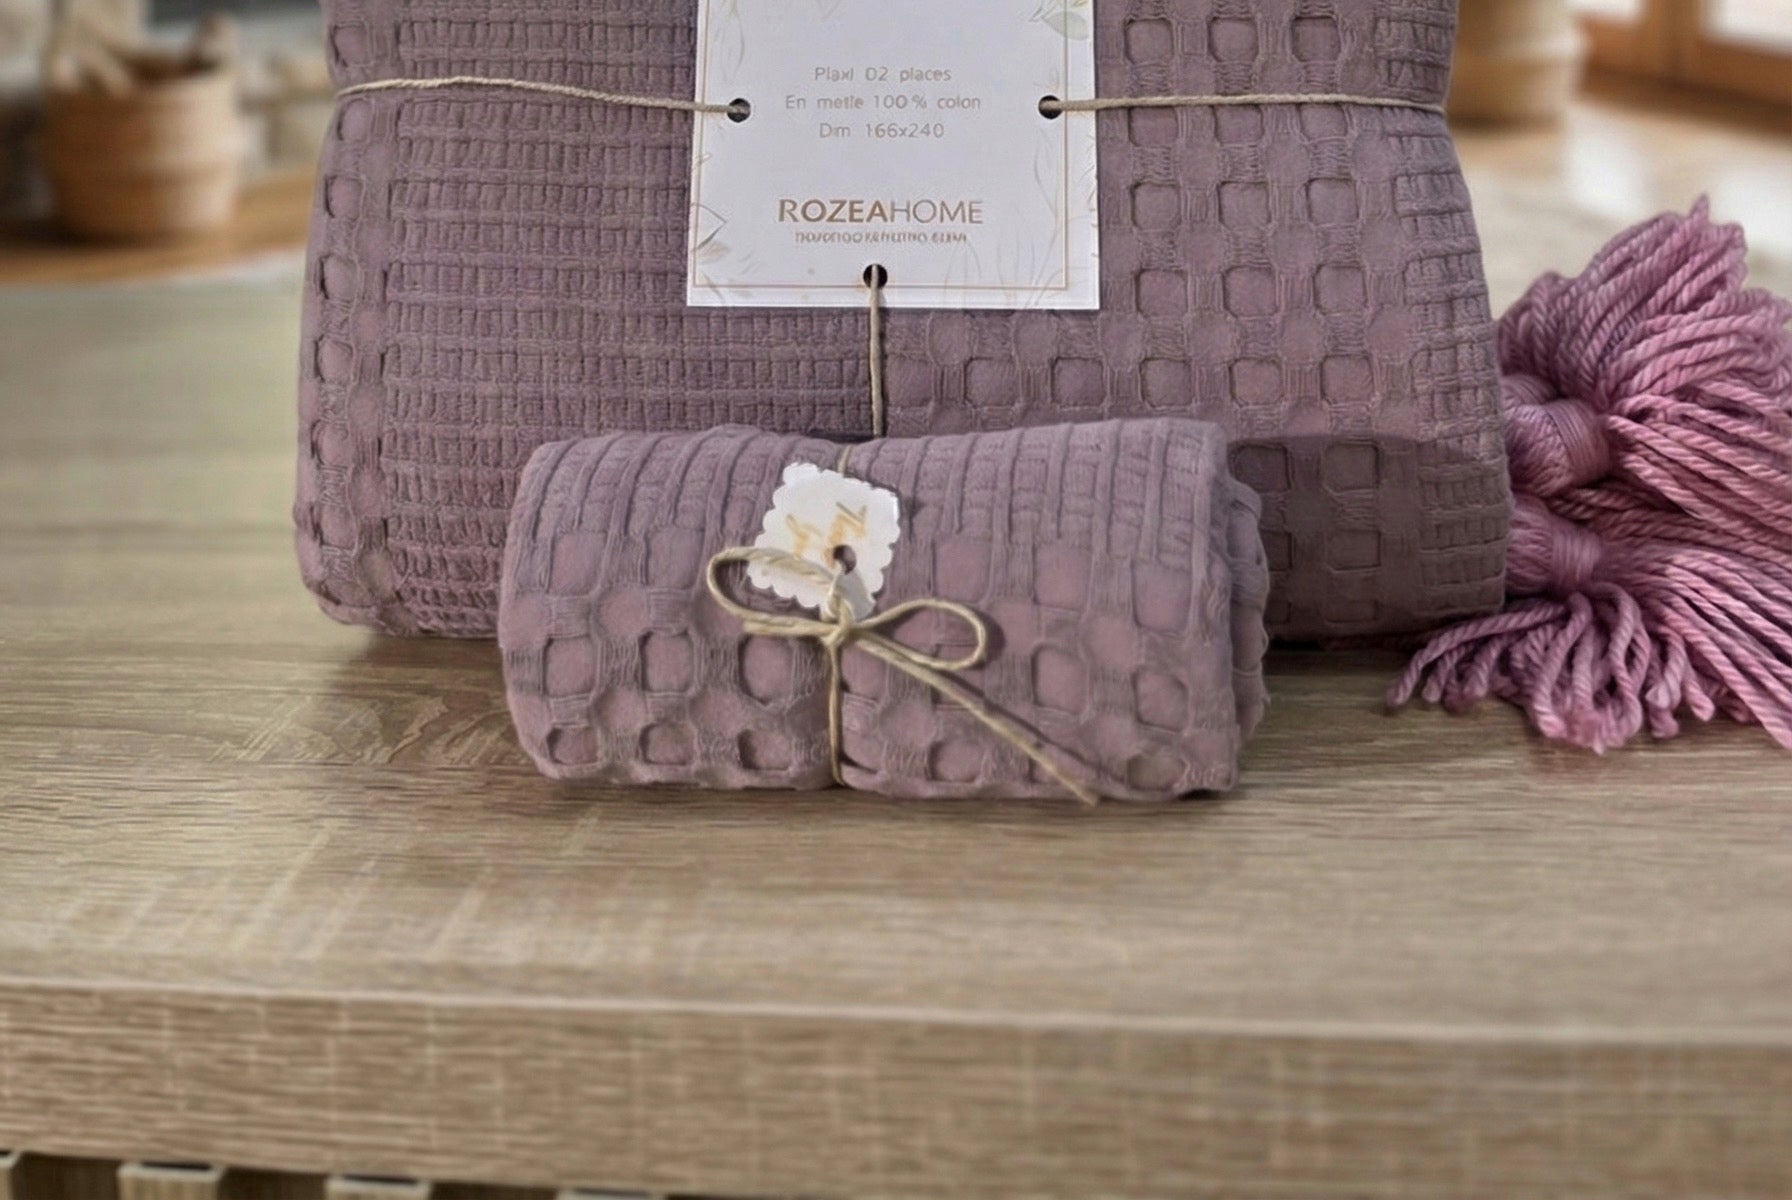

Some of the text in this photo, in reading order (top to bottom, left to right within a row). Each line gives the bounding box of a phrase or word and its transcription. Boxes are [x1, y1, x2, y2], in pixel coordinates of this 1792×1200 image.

[899, 67, 952, 83] places
[785, 95, 806, 110] En
[865, 122, 945, 139] 166x240
[778, 199, 984, 224] ROZEAHOME
